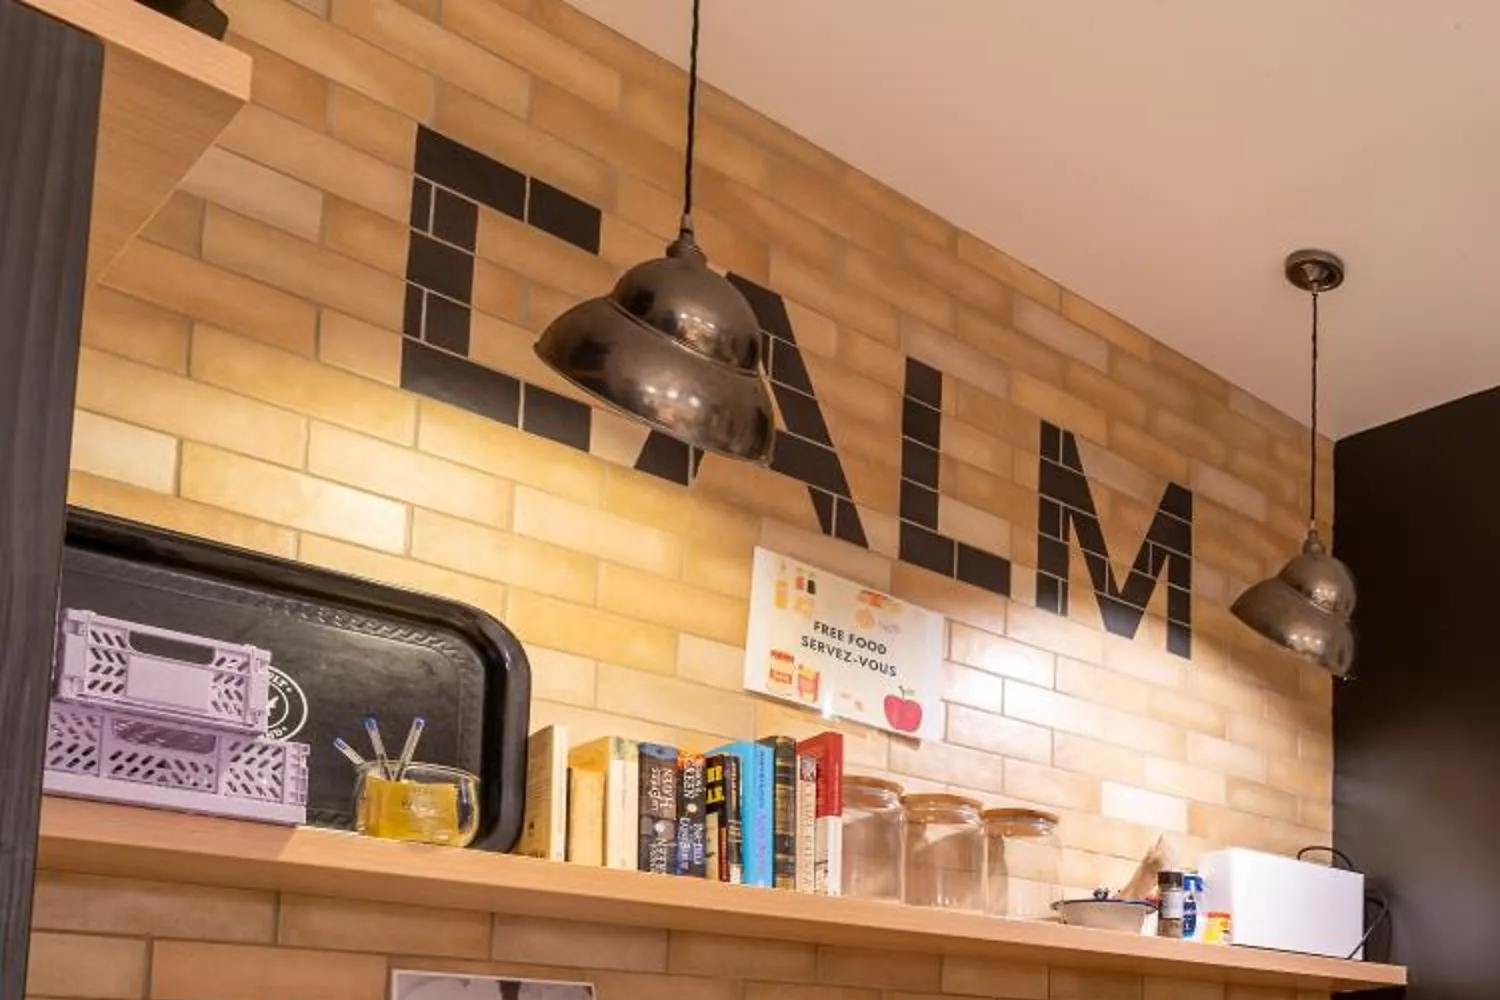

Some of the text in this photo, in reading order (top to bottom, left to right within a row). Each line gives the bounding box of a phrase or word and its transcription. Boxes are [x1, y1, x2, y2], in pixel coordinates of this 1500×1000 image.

[401, 124, 1192, 659] CALM
[801, 635, 897, 677] SERVEZ-VOUS
[813, 621, 888, 655] FREE FOOD
